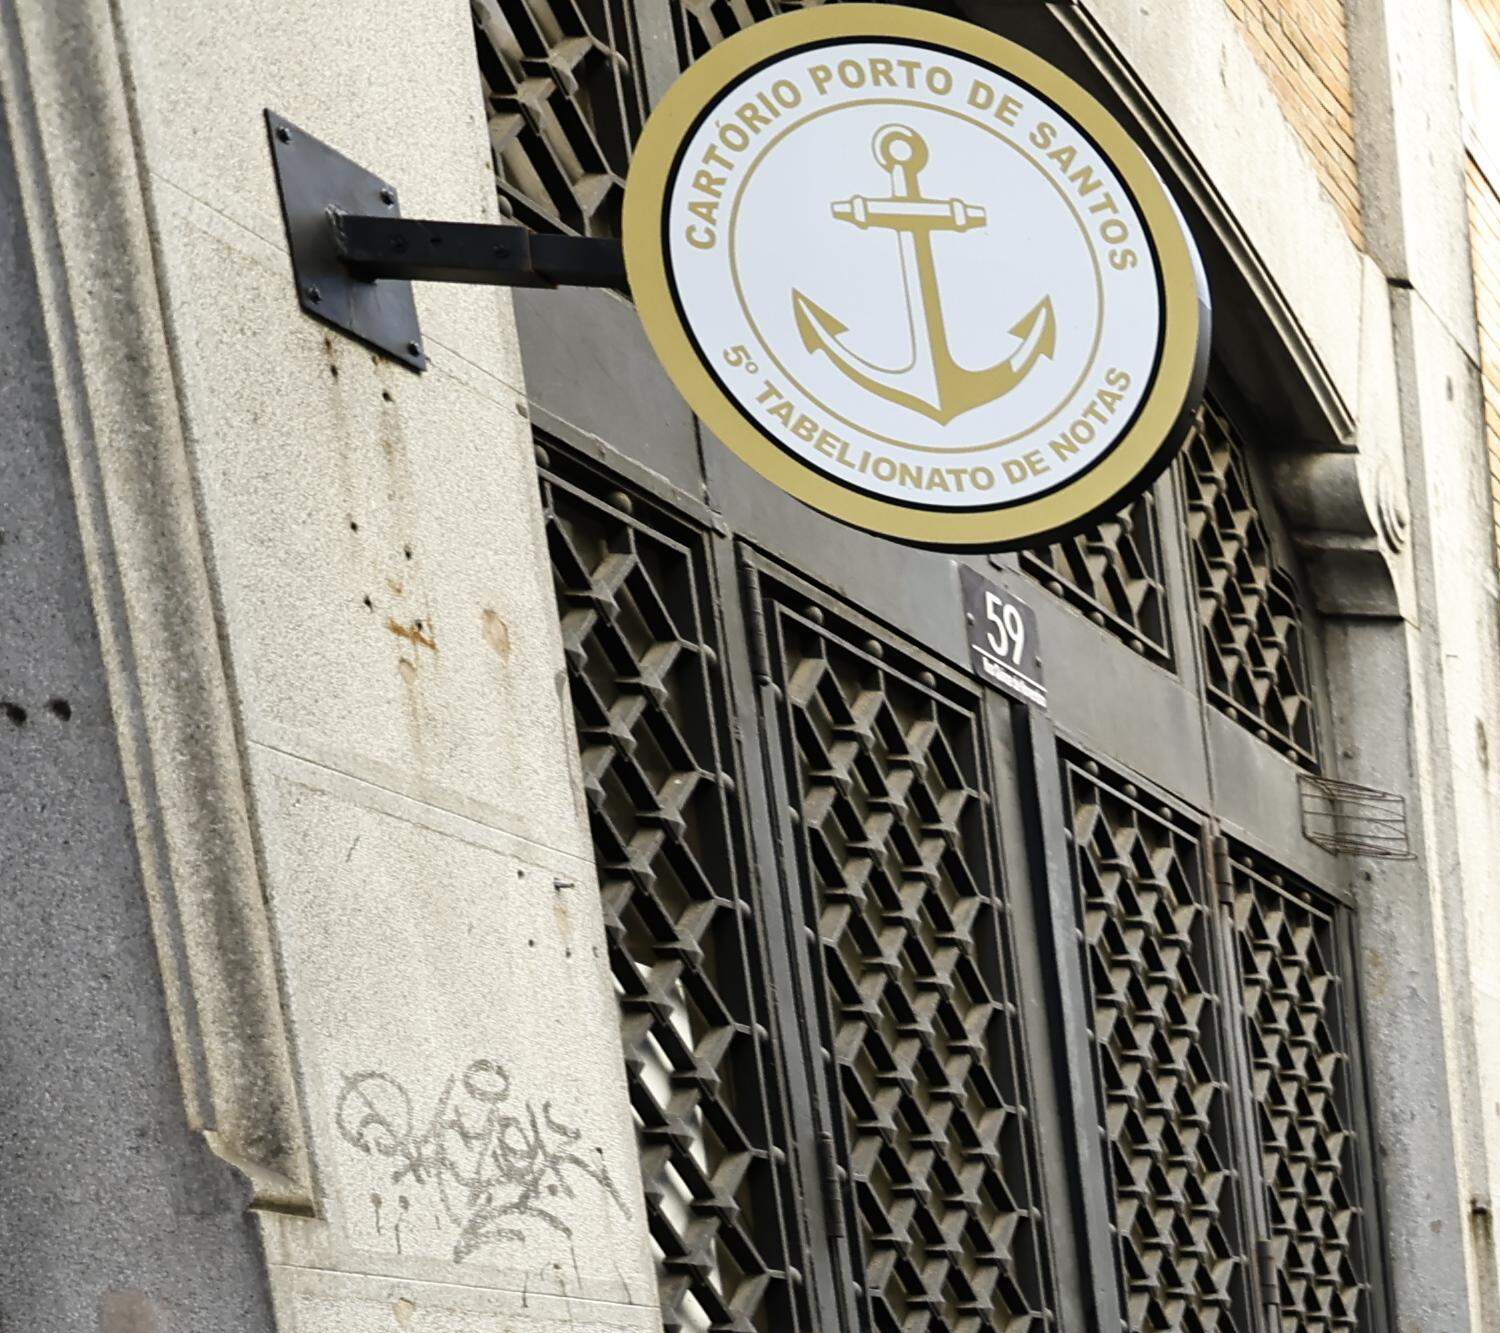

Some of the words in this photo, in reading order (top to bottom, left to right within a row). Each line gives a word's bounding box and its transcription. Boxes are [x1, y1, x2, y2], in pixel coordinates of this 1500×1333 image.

[685, 78, 803, 251] CARTÓRIO
[808, 58, 954, 96] PORTO
[966, 79, 1024, 127] DE
[1028, 121, 1138, 272] SANTOS
[757, 382, 996, 494] TABELIONATO
[1003, 451, 1050, 487] DE
[1052, 367, 1131, 464] NOTAS
[985, 591, 1024, 665] 59
